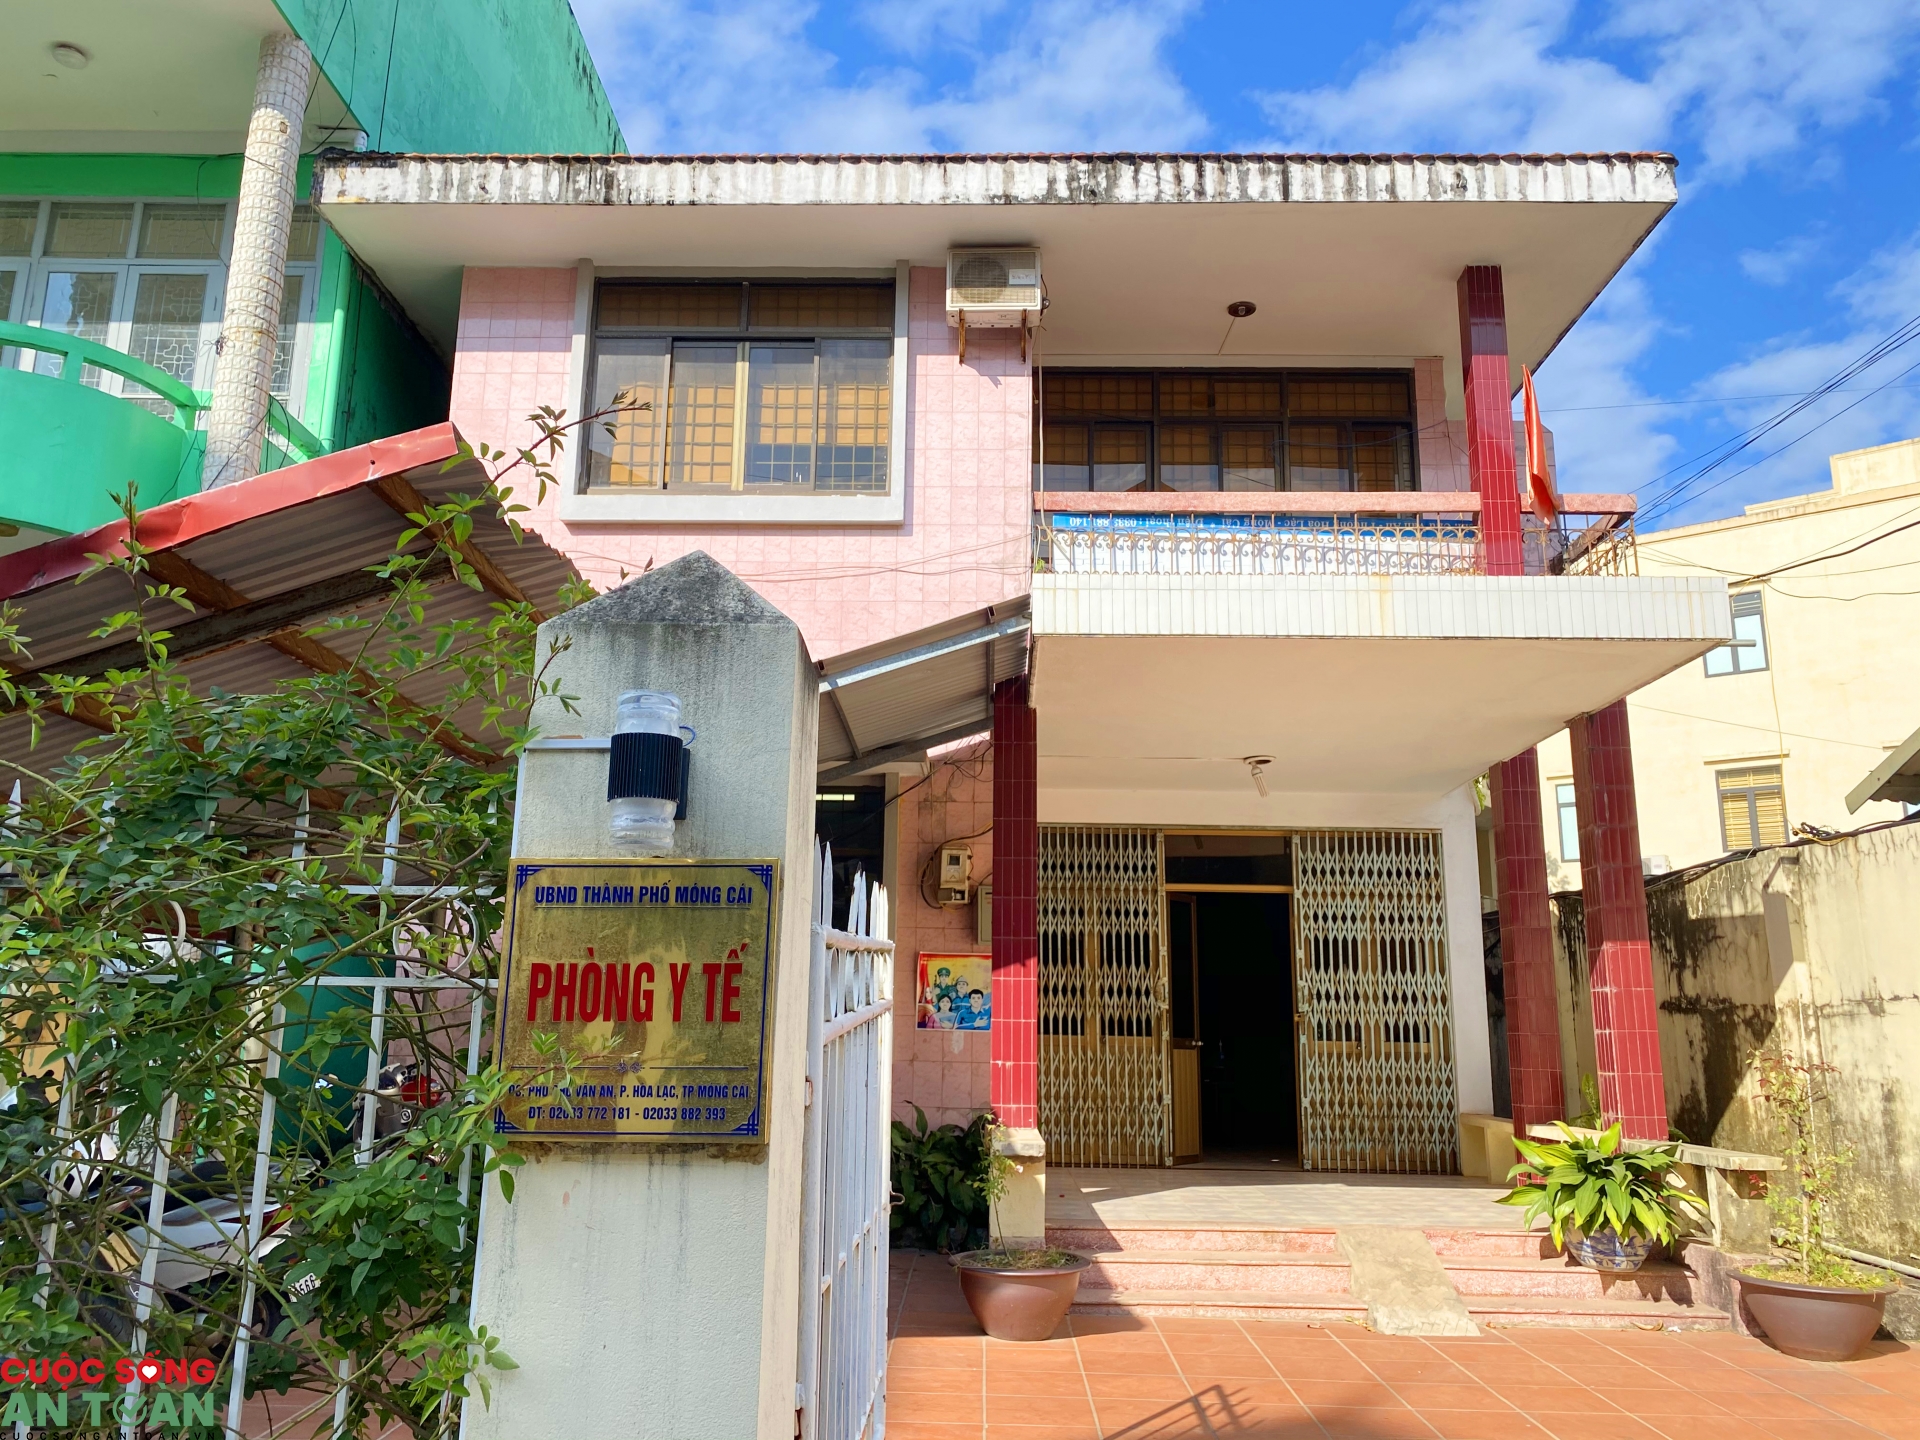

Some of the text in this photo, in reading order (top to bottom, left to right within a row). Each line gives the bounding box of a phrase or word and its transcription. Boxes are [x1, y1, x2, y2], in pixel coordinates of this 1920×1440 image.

[535, 880, 753, 904] UBND THÀNH PHỐ MÓNG CÁI
[527, 943, 749, 1023] PHÒNG Y TẾ
[576, 1082, 596, 1098] VĂN
[620, 1085, 630, 1098] P.
[632, 1082, 653, 1098] HÒA
[656, 1085, 679, 1101] LẠC,
[682, 1085, 695, 1098] TP
[697, 1082, 729, 1098] MÓNG
[731, 1082, 749, 1098] CÁI
[528, 1106, 546, 1119] ĐT:
[587, 1106, 608, 1120] 772
[612, 1106, 631, 1120] 181
[643, 1107, 677, 1120] 02033
[681, 1107, 702, 1120] 882
[705, 1107, 726, 1120] 393
